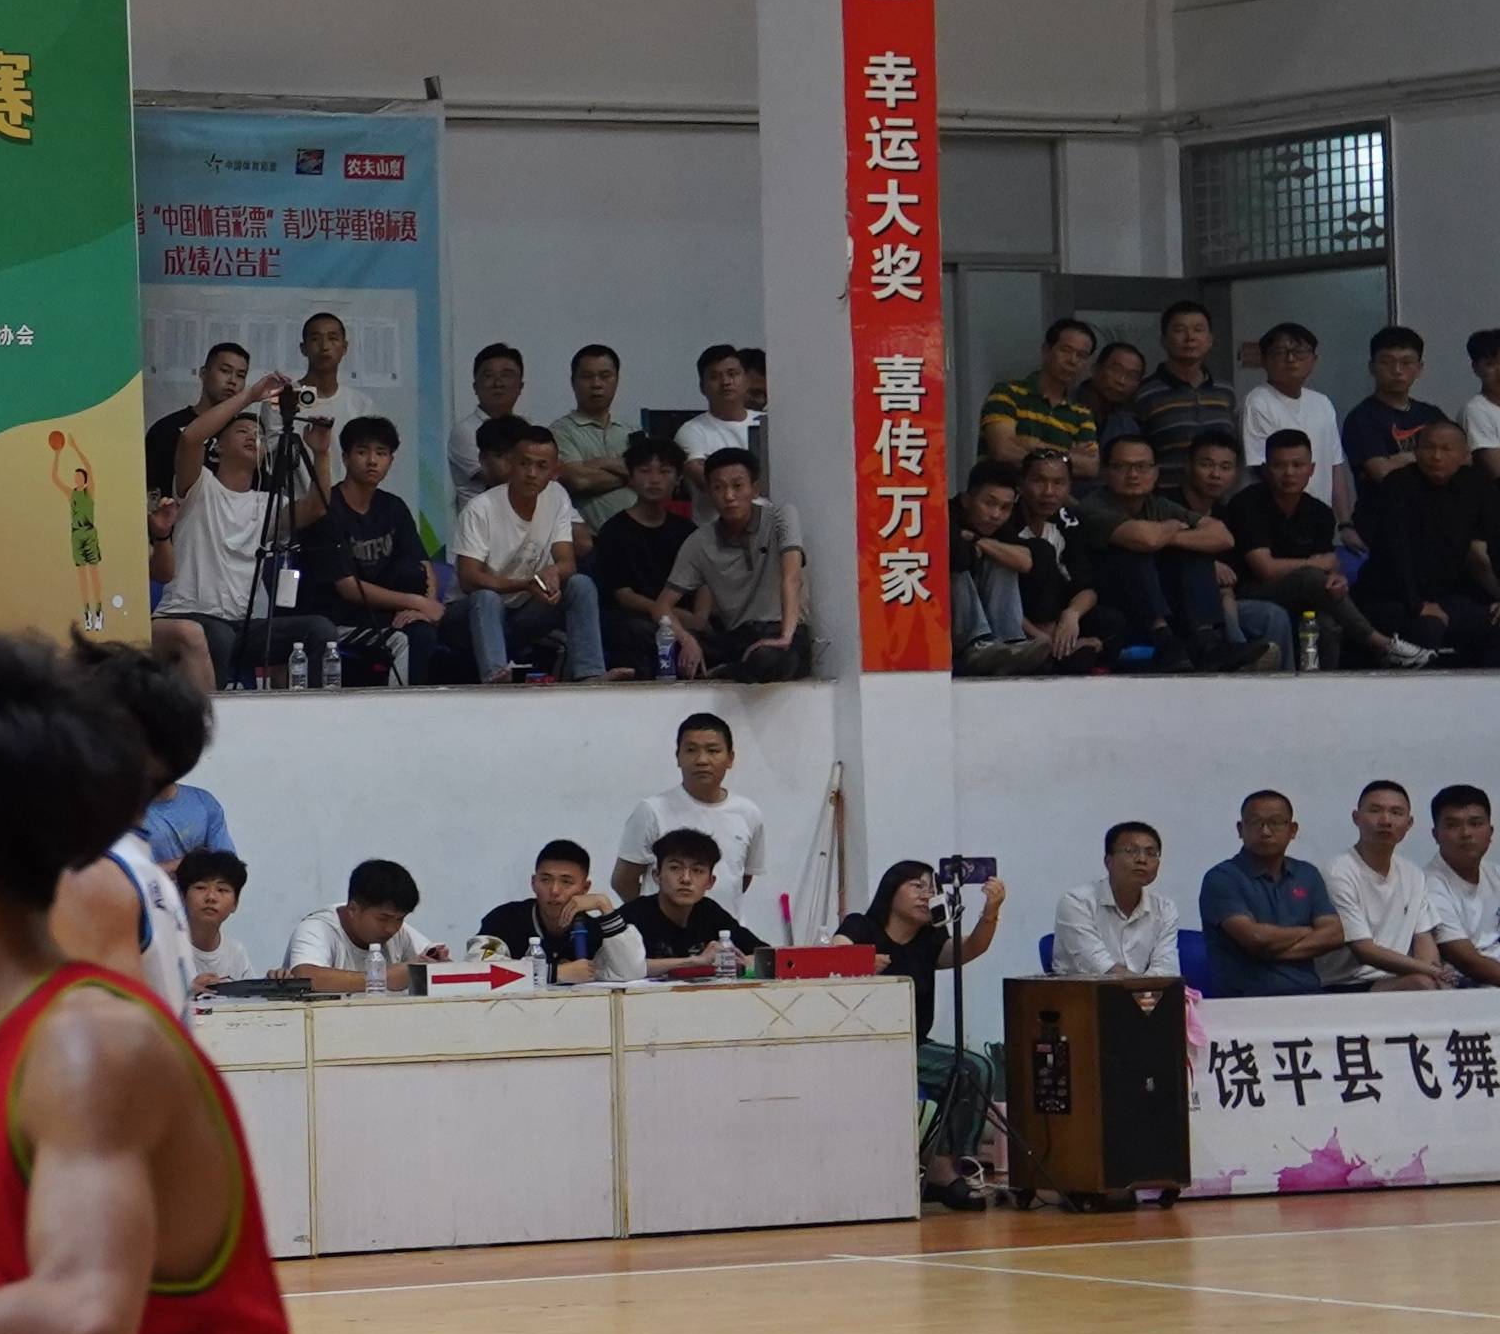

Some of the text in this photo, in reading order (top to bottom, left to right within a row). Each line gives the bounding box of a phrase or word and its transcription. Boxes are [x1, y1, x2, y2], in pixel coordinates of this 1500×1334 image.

[863, 50, 924, 303] 幸运大奖
[163, 246, 282, 279] 成绩公告栏
[871, 353, 932, 606] 喜传万家
[1208, 1028, 1500, 1109] 饶平县飞舞
